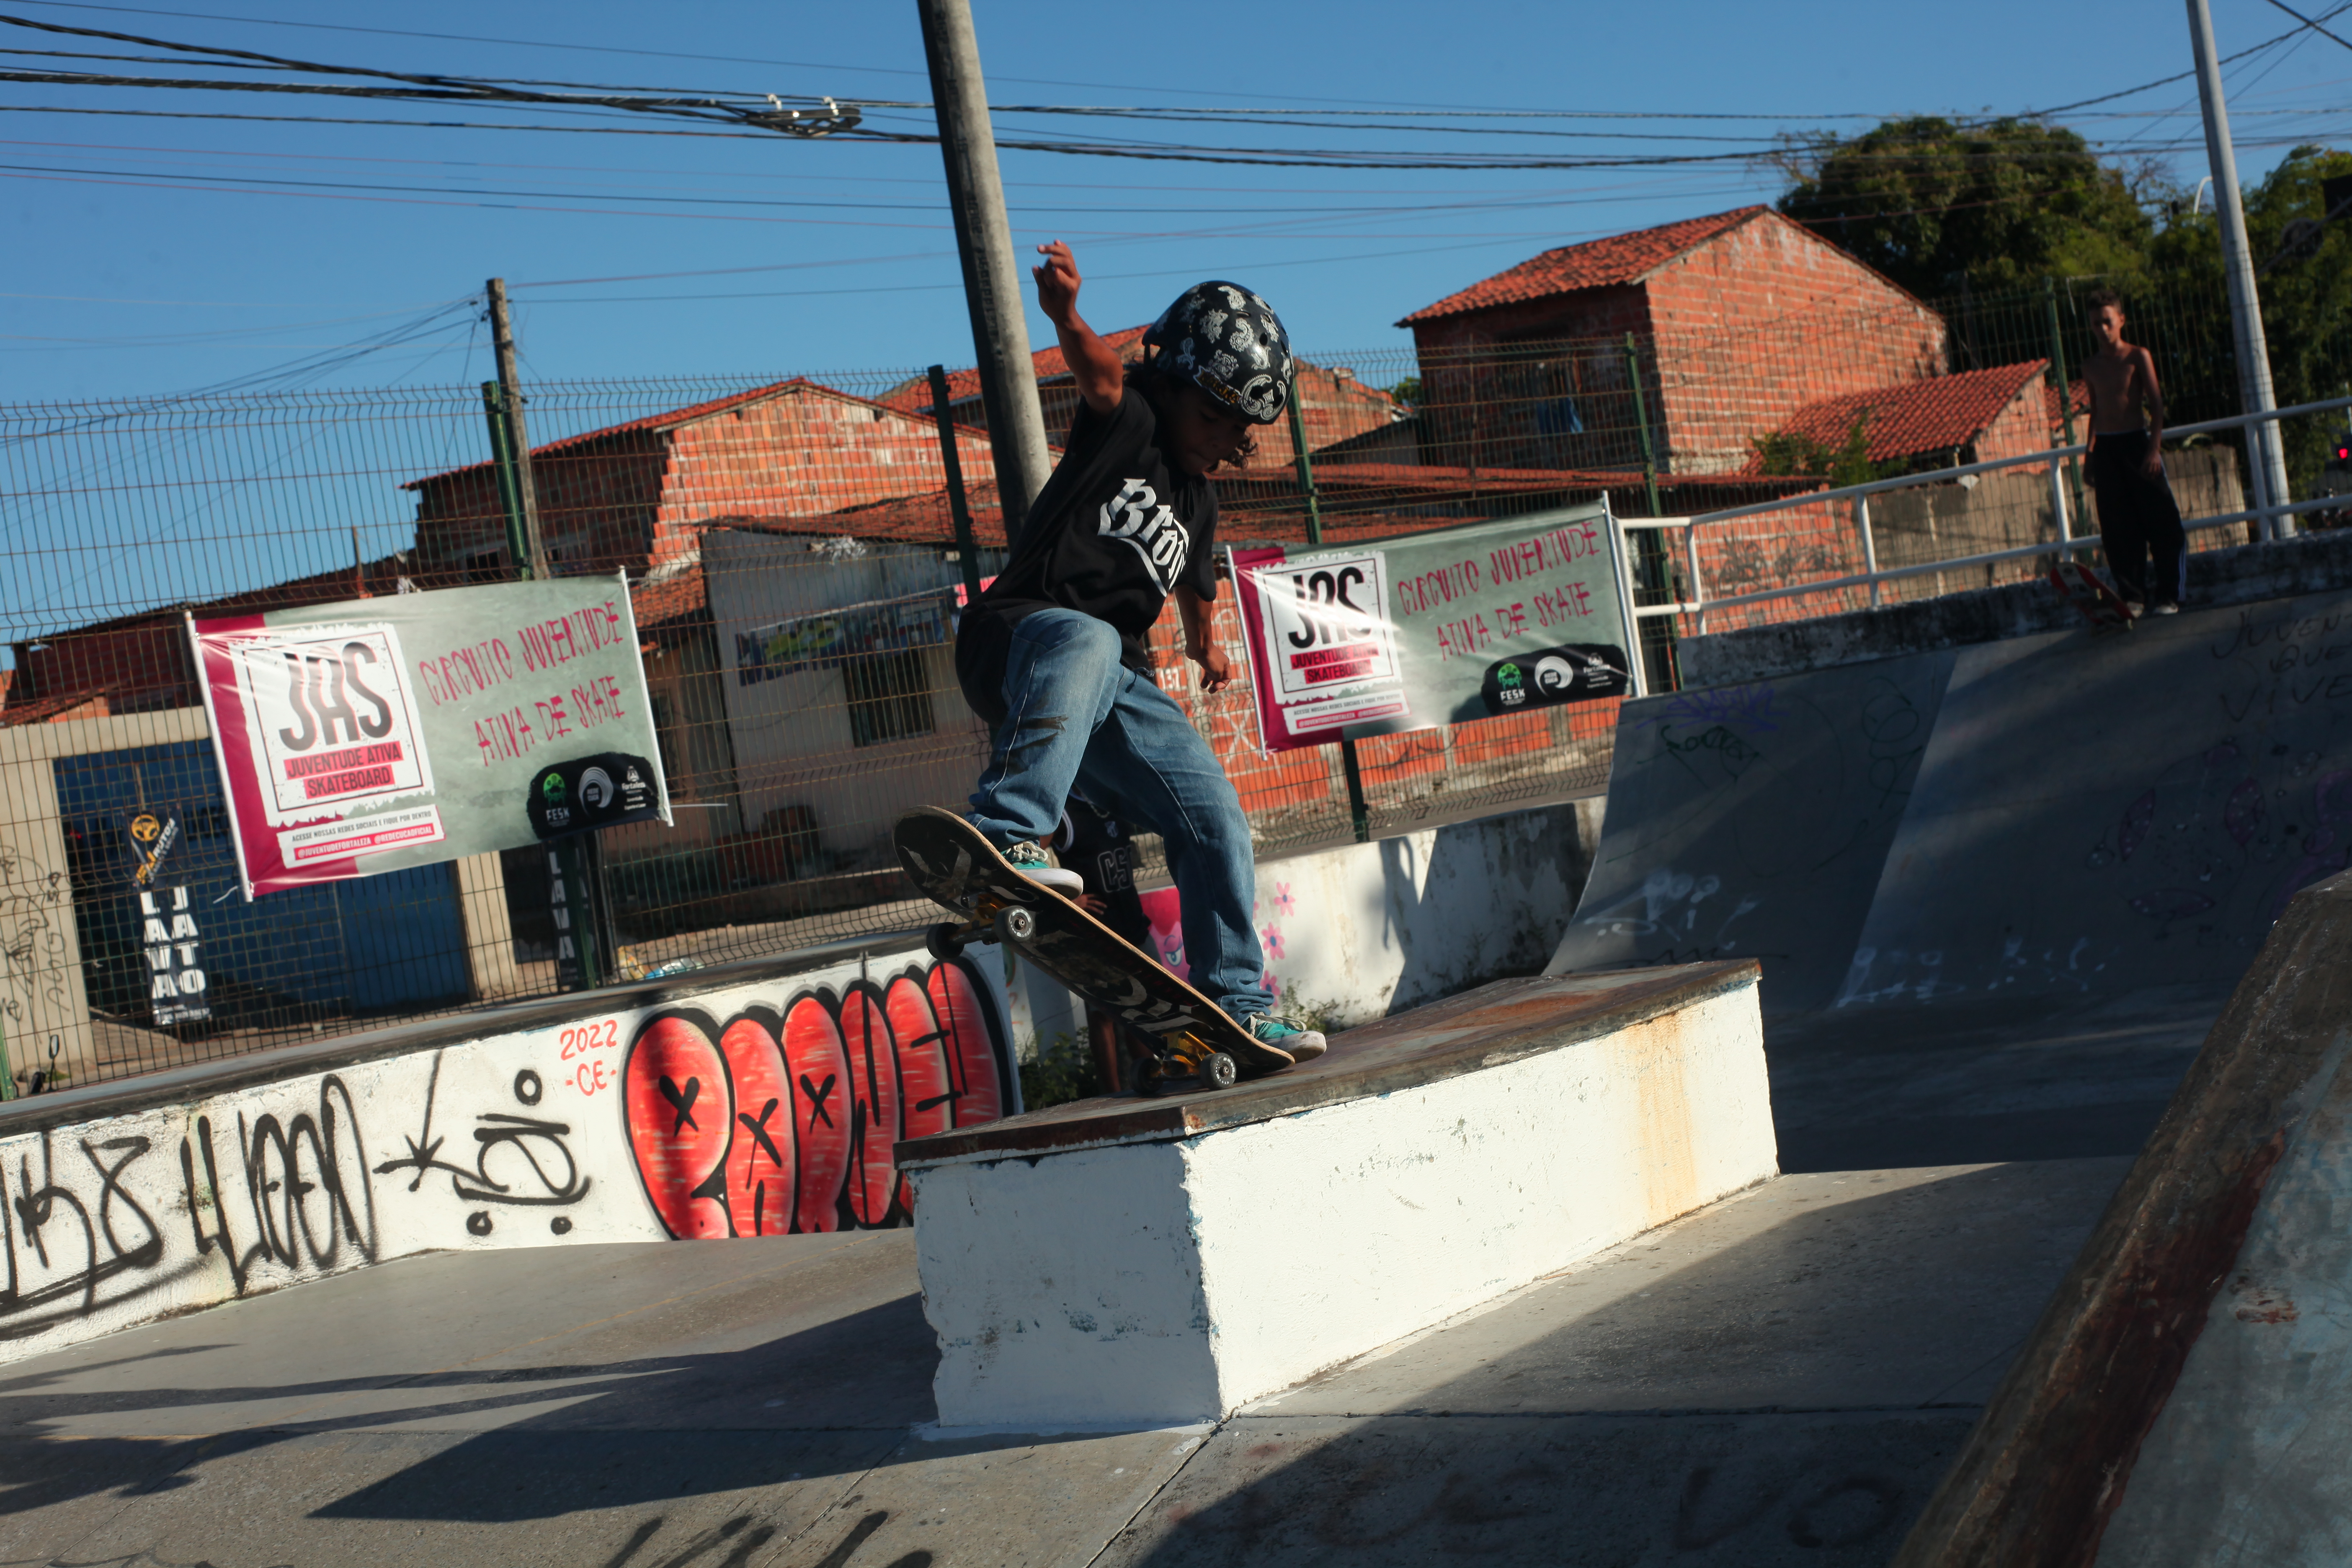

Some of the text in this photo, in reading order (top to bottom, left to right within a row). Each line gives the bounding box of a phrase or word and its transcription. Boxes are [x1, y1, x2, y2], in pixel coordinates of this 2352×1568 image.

[1398, 522, 1598, 616] CIRCUITO JUVENTUDE
[1288, 567, 1372, 648] JAS
[1437, 582, 1594, 662] ATIVA DE SKATE
[418, 601, 624, 706] CIRCUITO JUVENTUDE
[1293, 645, 1378, 668] JUVENTUDE ATIVA
[1308, 661, 1370, 682] SKATEBOARD
[279, 642, 392, 750] JAS
[1500, 688, 1525, 701] FESK
[474, 675, 625, 766] ATIVA DE SKATE
[288, 743, 401, 777] JUVENTUDE ATIVA
[307, 768, 391, 796] SKATEBOARD
[292, 832, 312, 842] ACESSE
[314, 828, 336, 837] NOSSAS
[337, 825, 354, 833] REDES
[356, 820, 377, 830] SOCIAIS
[383, 816, 398, 825] FIQUE
[411, 810, 432, 820] DENTRO
[547, 807, 570, 820] FESK
[298, 827, 433, 858] @JUVENTUDEFORTALEZA @REDECUCAOFICIAL
[140, 891, 179, 999] LAVA
[173, 886, 206, 994] JATO
[560, 1020, 617, 1060] 2022
